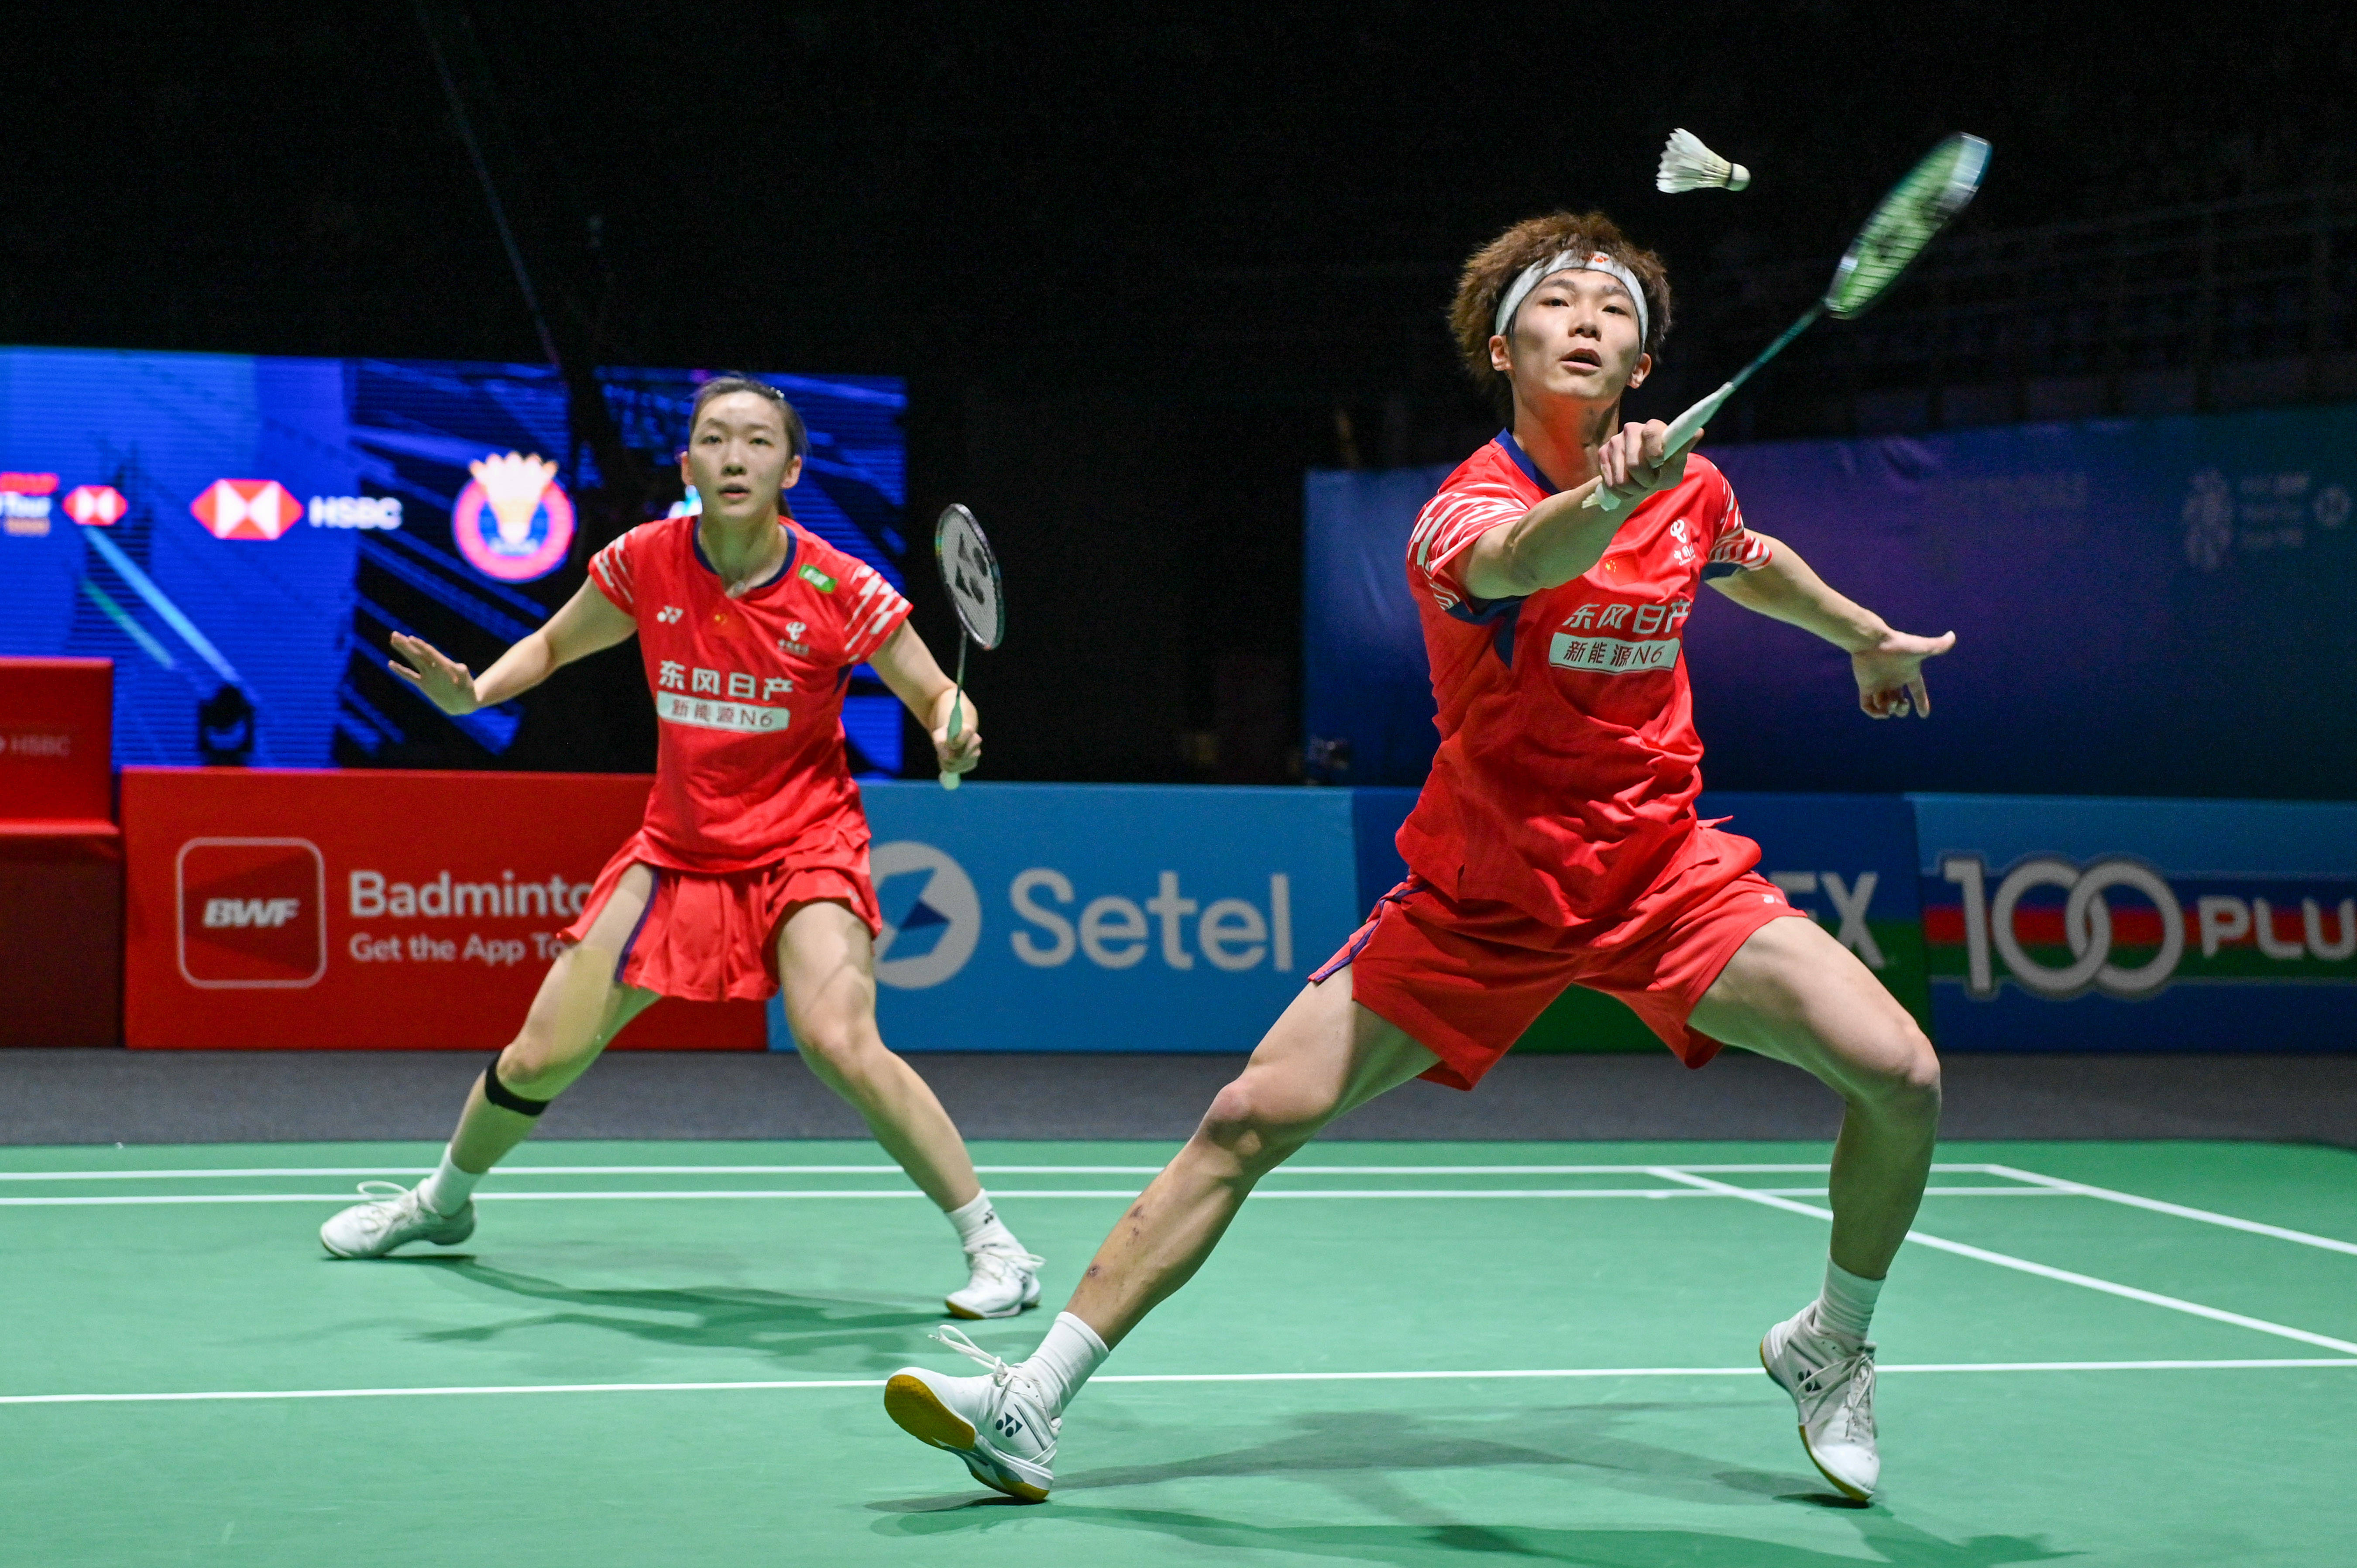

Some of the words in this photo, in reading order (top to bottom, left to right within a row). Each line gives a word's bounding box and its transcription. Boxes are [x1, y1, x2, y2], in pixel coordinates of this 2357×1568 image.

[309, 496, 402, 530] HSBC
[1562, 599, 1690, 634] 东风日产
[1563, 641, 1665, 667] 新能源N6
[659, 660, 793, 701] 东风日产
[350, 870, 593, 917] Badminto
[203, 898, 300, 928] BWF
[1010, 868, 1293, 971] Setel
[1943, 858, 2183, 993] 100
[2198, 895, 2357, 961] PLU
[350, 933, 402, 961] Get
[409, 933, 456, 961] the
[463, 933, 526, 967] App
